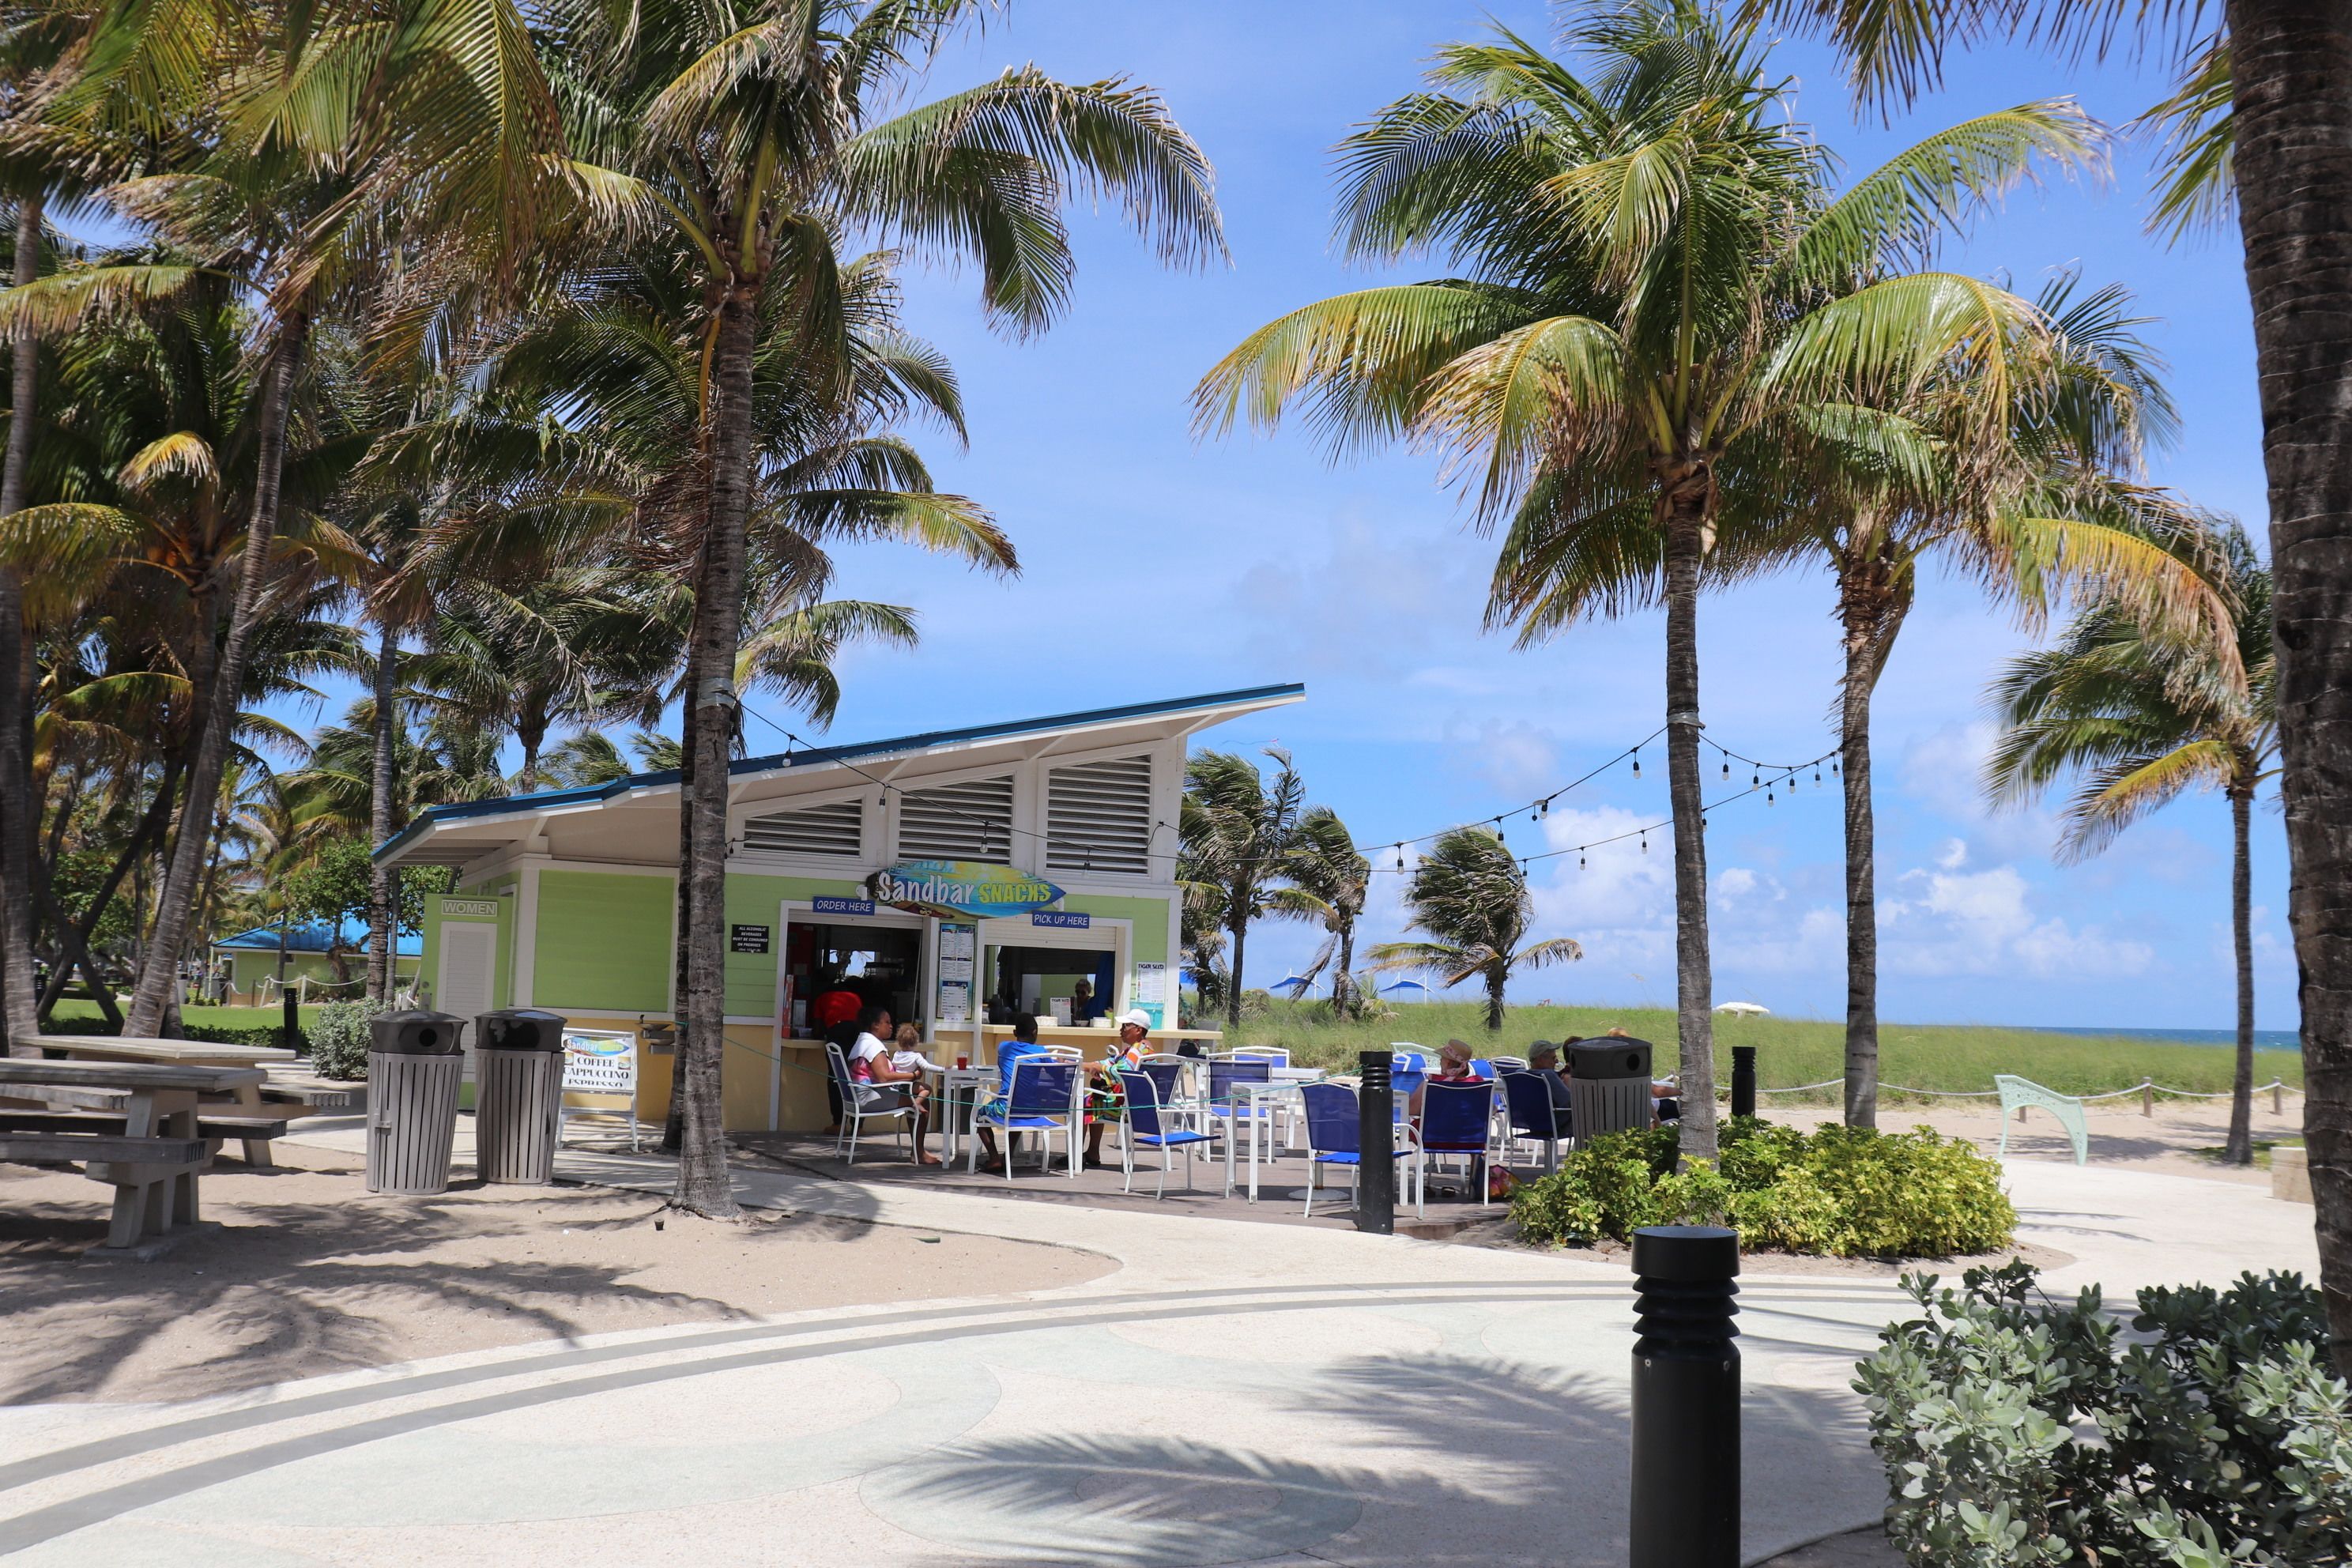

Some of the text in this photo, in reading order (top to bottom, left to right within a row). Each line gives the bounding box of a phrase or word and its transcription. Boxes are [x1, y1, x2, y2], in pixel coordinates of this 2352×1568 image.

[878, 872, 1052, 904] Sandbar SNACKS
[444, 902, 495, 914] WOMEN
[816, 900, 872, 912] ORDER HERE
[1034, 914, 1088, 925] PICK UP HERE
[567, 1038, 597, 1052] Sandbar
[577, 1056, 614, 1067] COFFEE
[564, 1067, 629, 1080] CAPPUCCINO
